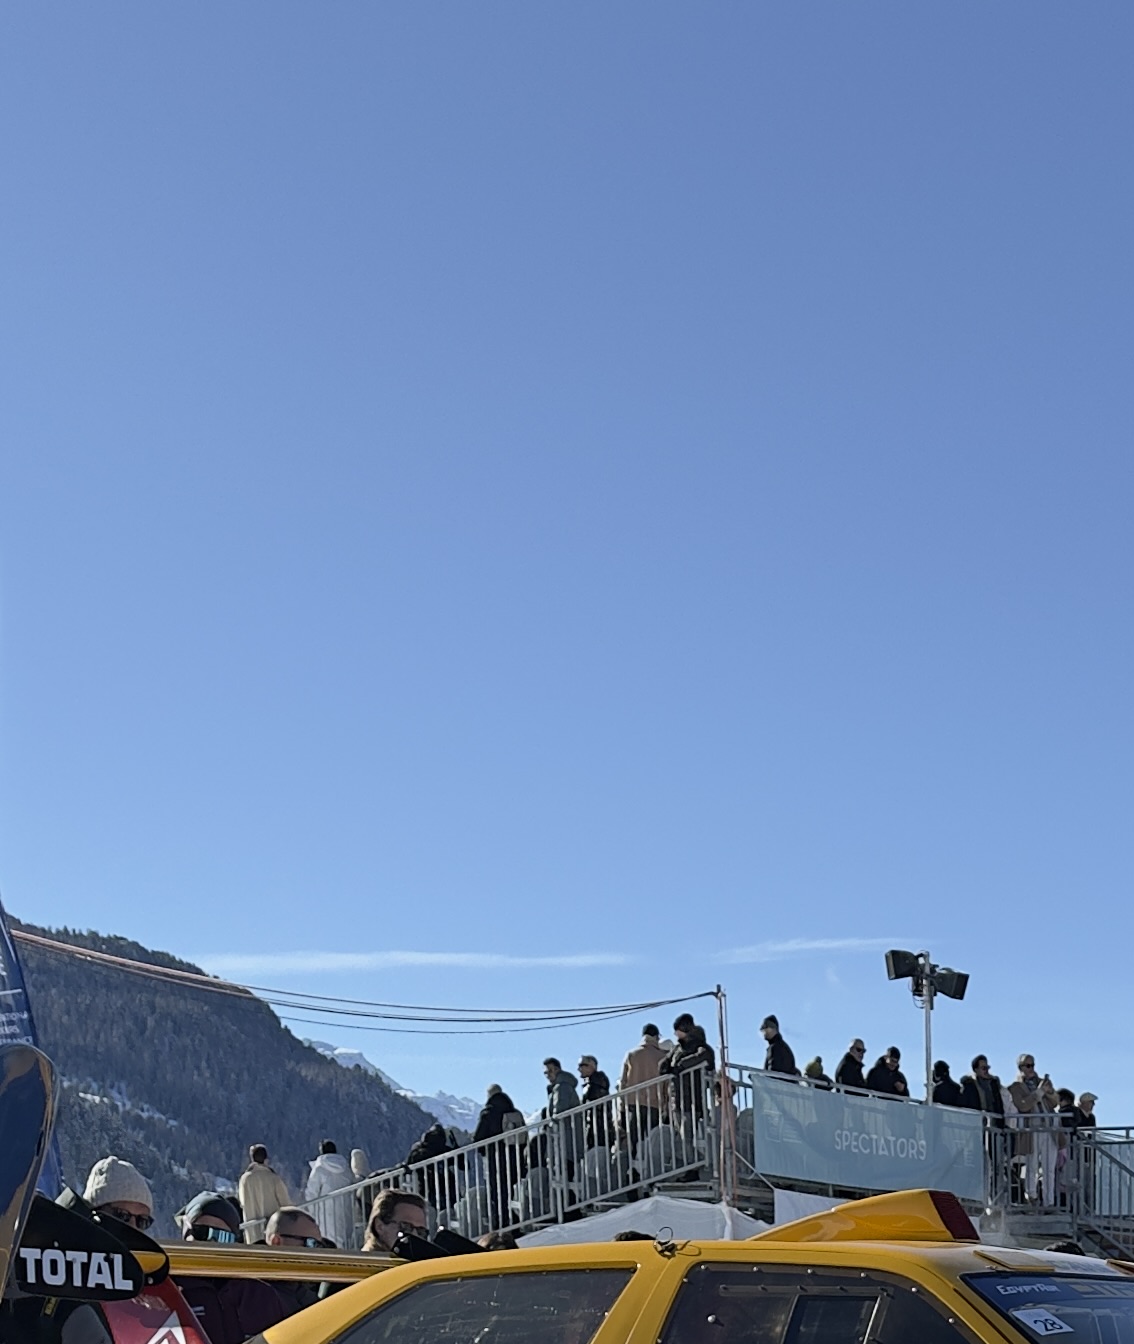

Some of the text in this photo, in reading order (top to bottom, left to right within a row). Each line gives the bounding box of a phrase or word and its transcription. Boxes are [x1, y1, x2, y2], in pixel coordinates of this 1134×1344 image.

[834, 1129, 927, 1161] SPECTATORS
[19, 1247, 134, 1291] TOTAL
[1034, 1318, 1063, 1332] 28
